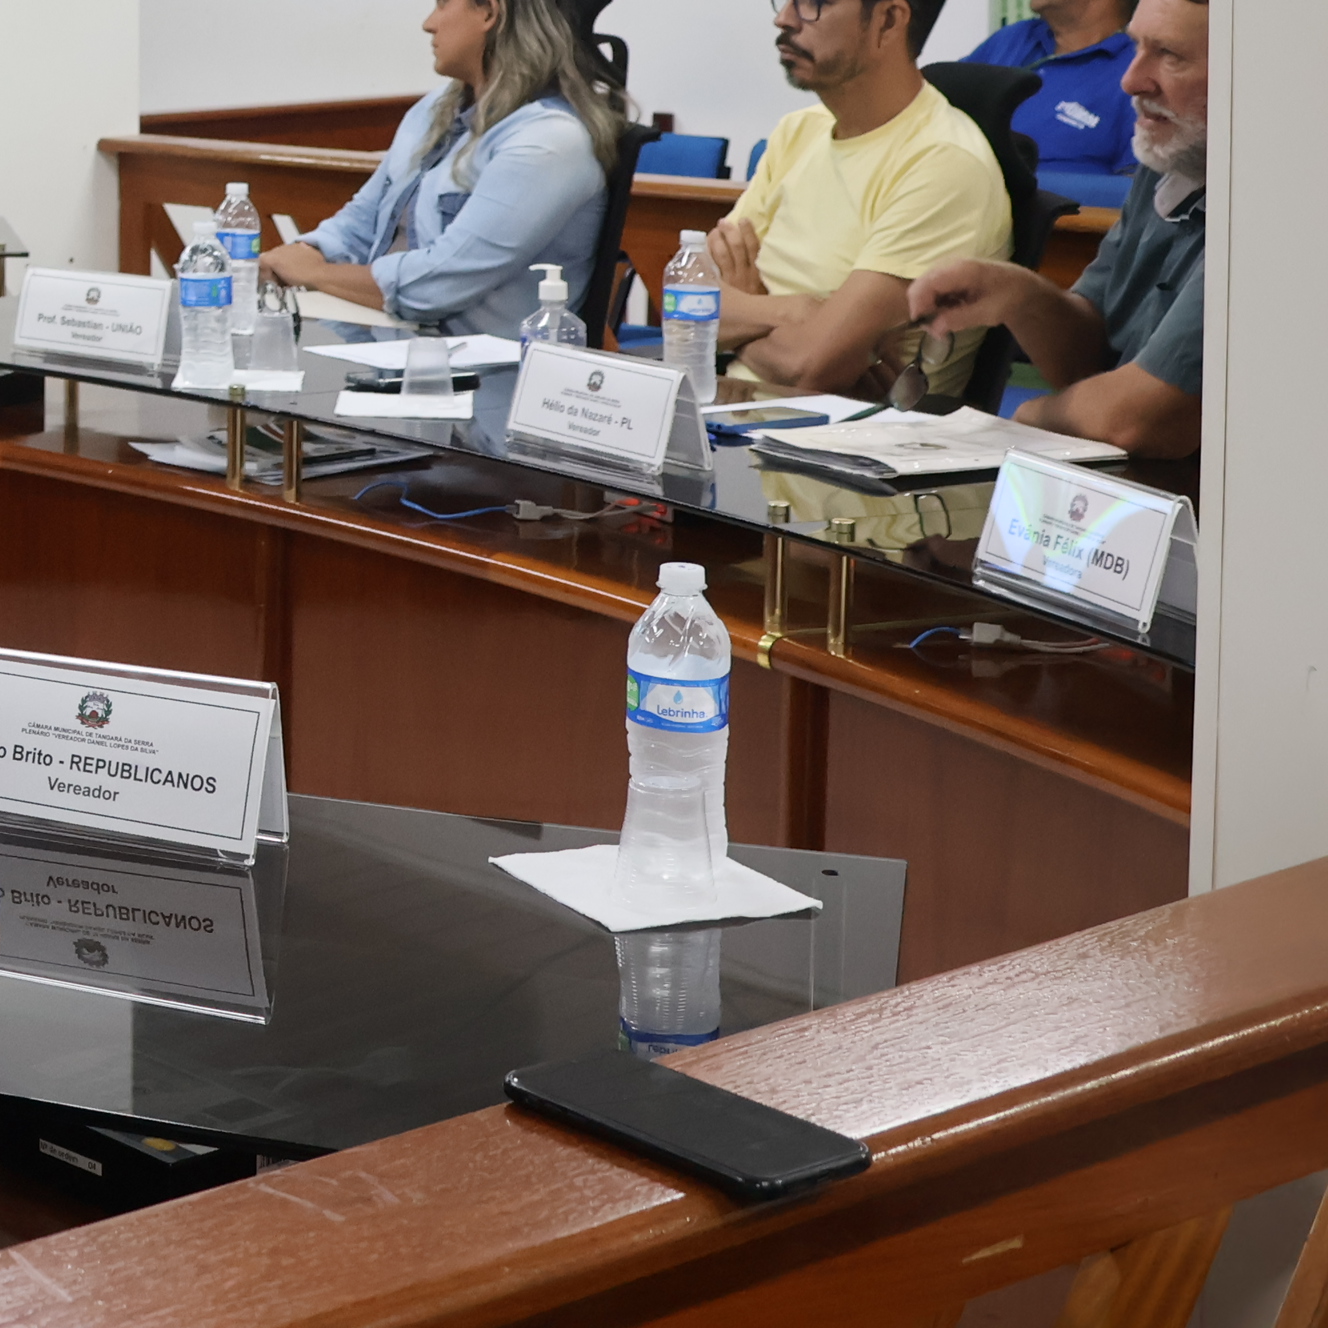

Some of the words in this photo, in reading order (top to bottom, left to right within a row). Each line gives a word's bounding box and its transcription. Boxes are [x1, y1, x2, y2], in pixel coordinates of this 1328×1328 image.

[37, 313, 57, 324] Prof.
[111, 322, 143, 336] UNIÃO
[567, 420, 601, 436] Vereador
[580, 407, 613, 425] Nazaré
[620, 417, 633, 430] PL
[1042, 555, 1083, 580] Vereadora
[1052, 535, 1083, 561] Félix
[1086, 548, 1130, 581] (MDB)
[21, 727, 51, 738] PLENÁRIO
[87, 739, 108, 748] DANIEL
[109, 742, 129, 751] LOPES
[27, 722, 53, 731] CÂMARA
[53, 726, 85, 737] MUNICIPAL
[94, 732, 123, 742] TANGARÁ
[133, 739, 155, 747] SERRA
[12, 744, 54, 767] Brito
[69, 754, 217, 794] REPUBLICANOS
[47, 776, 120, 802] Vereador
